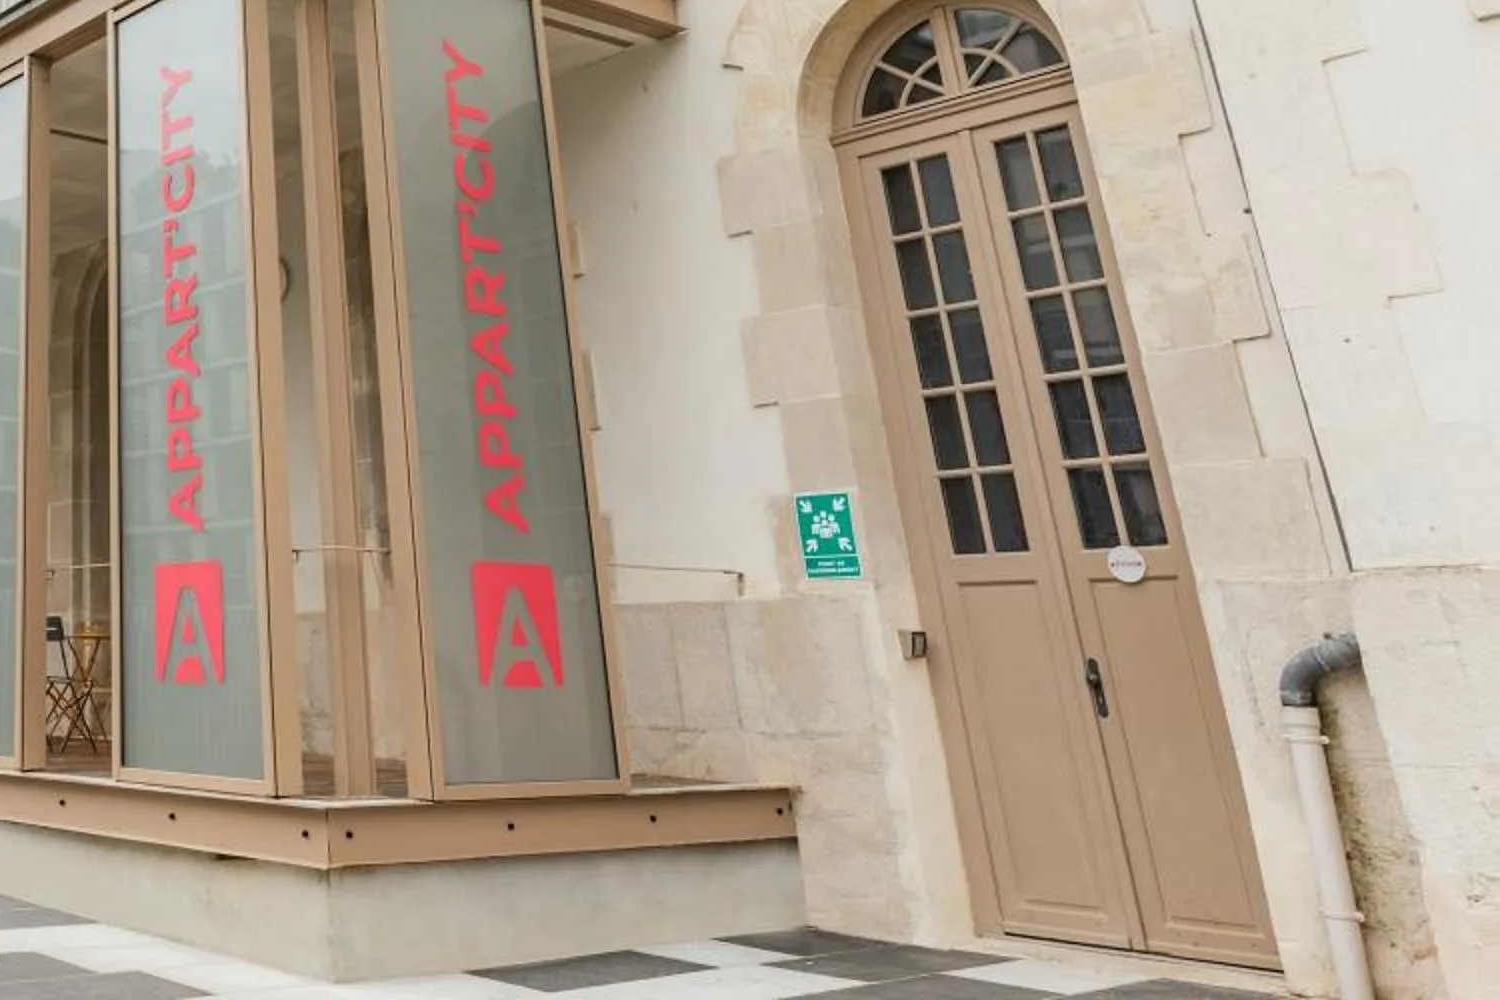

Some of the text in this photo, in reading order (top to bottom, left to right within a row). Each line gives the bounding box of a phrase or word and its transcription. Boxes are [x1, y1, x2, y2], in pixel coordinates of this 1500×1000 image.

[159, 64, 205, 533] APPART'CITY
[442, 39, 531, 535] APPART'CITY
[156, 569, 225, 686] A
[471, 568, 564, 689] A
